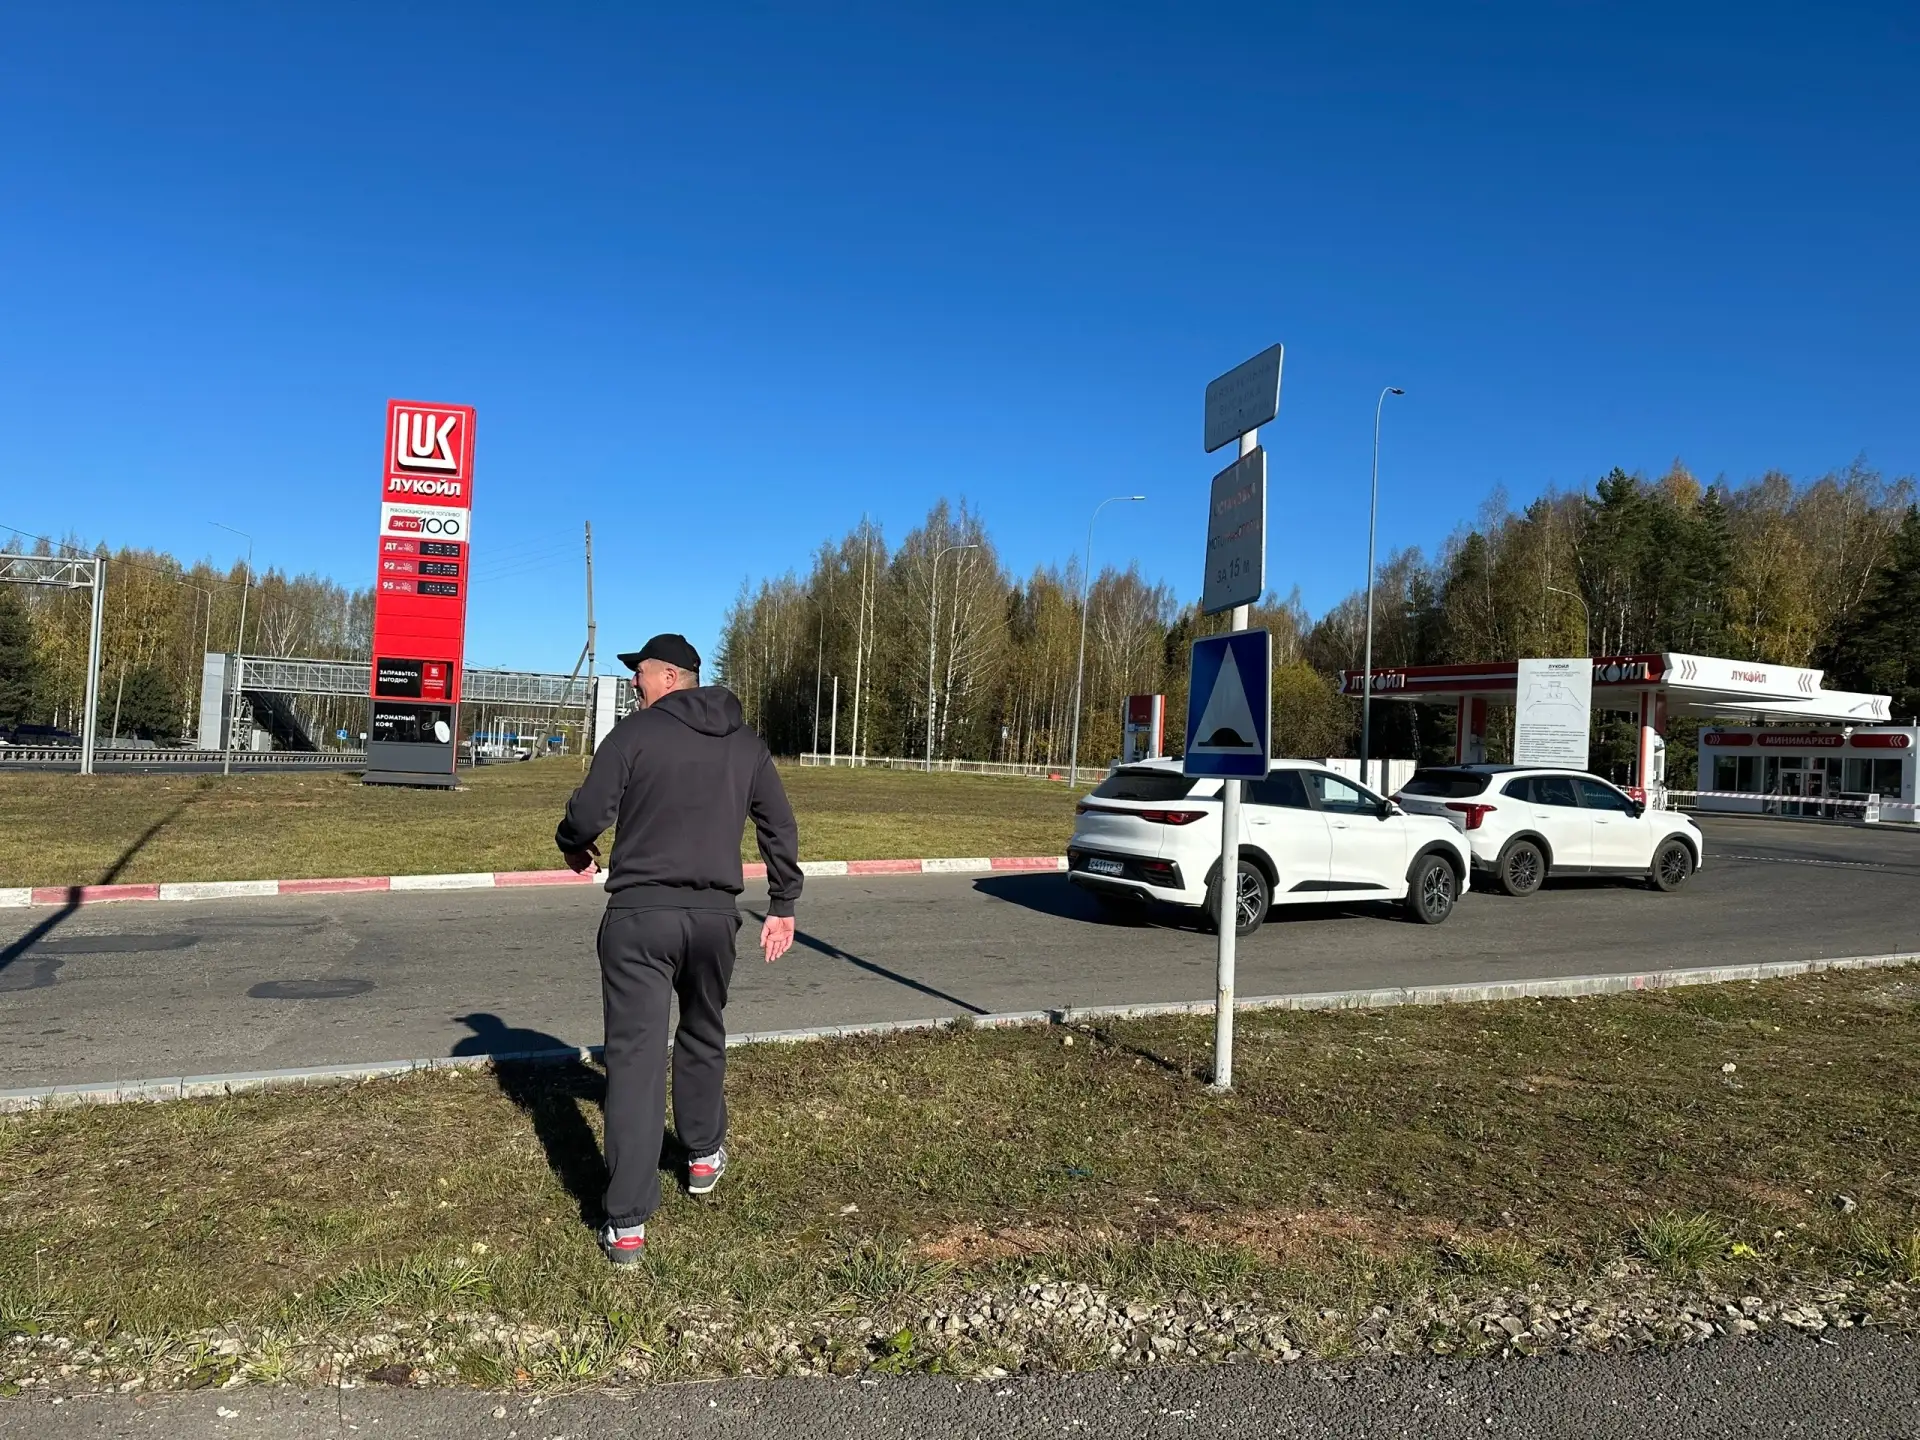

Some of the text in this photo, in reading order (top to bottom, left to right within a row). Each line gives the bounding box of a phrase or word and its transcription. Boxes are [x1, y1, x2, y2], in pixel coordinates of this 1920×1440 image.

[387, 477, 461, 496] ЛУКОЙЛ
[392, 518, 460, 535] ЭКТО 100
[384, 542, 398, 551] ДТ
[383, 562, 395, 570] 92
[1216, 568, 1227, 584] ЗА
[1229, 557, 1240, 579] 15
[382, 582, 394, 590] 95
[379, 669, 418, 677] ЗАПРАВЬТЕСЬ
[1592, 657, 1649, 682] КОЙЛ
[379, 676, 409, 684] ВЫГОДНО
[1731, 669, 1767, 684] ЛУКОЙЛ
[375, 713, 416, 721] АРОМАТНЫЙ
[1765, 735, 1837, 745] МИНИМАРКЕТ
